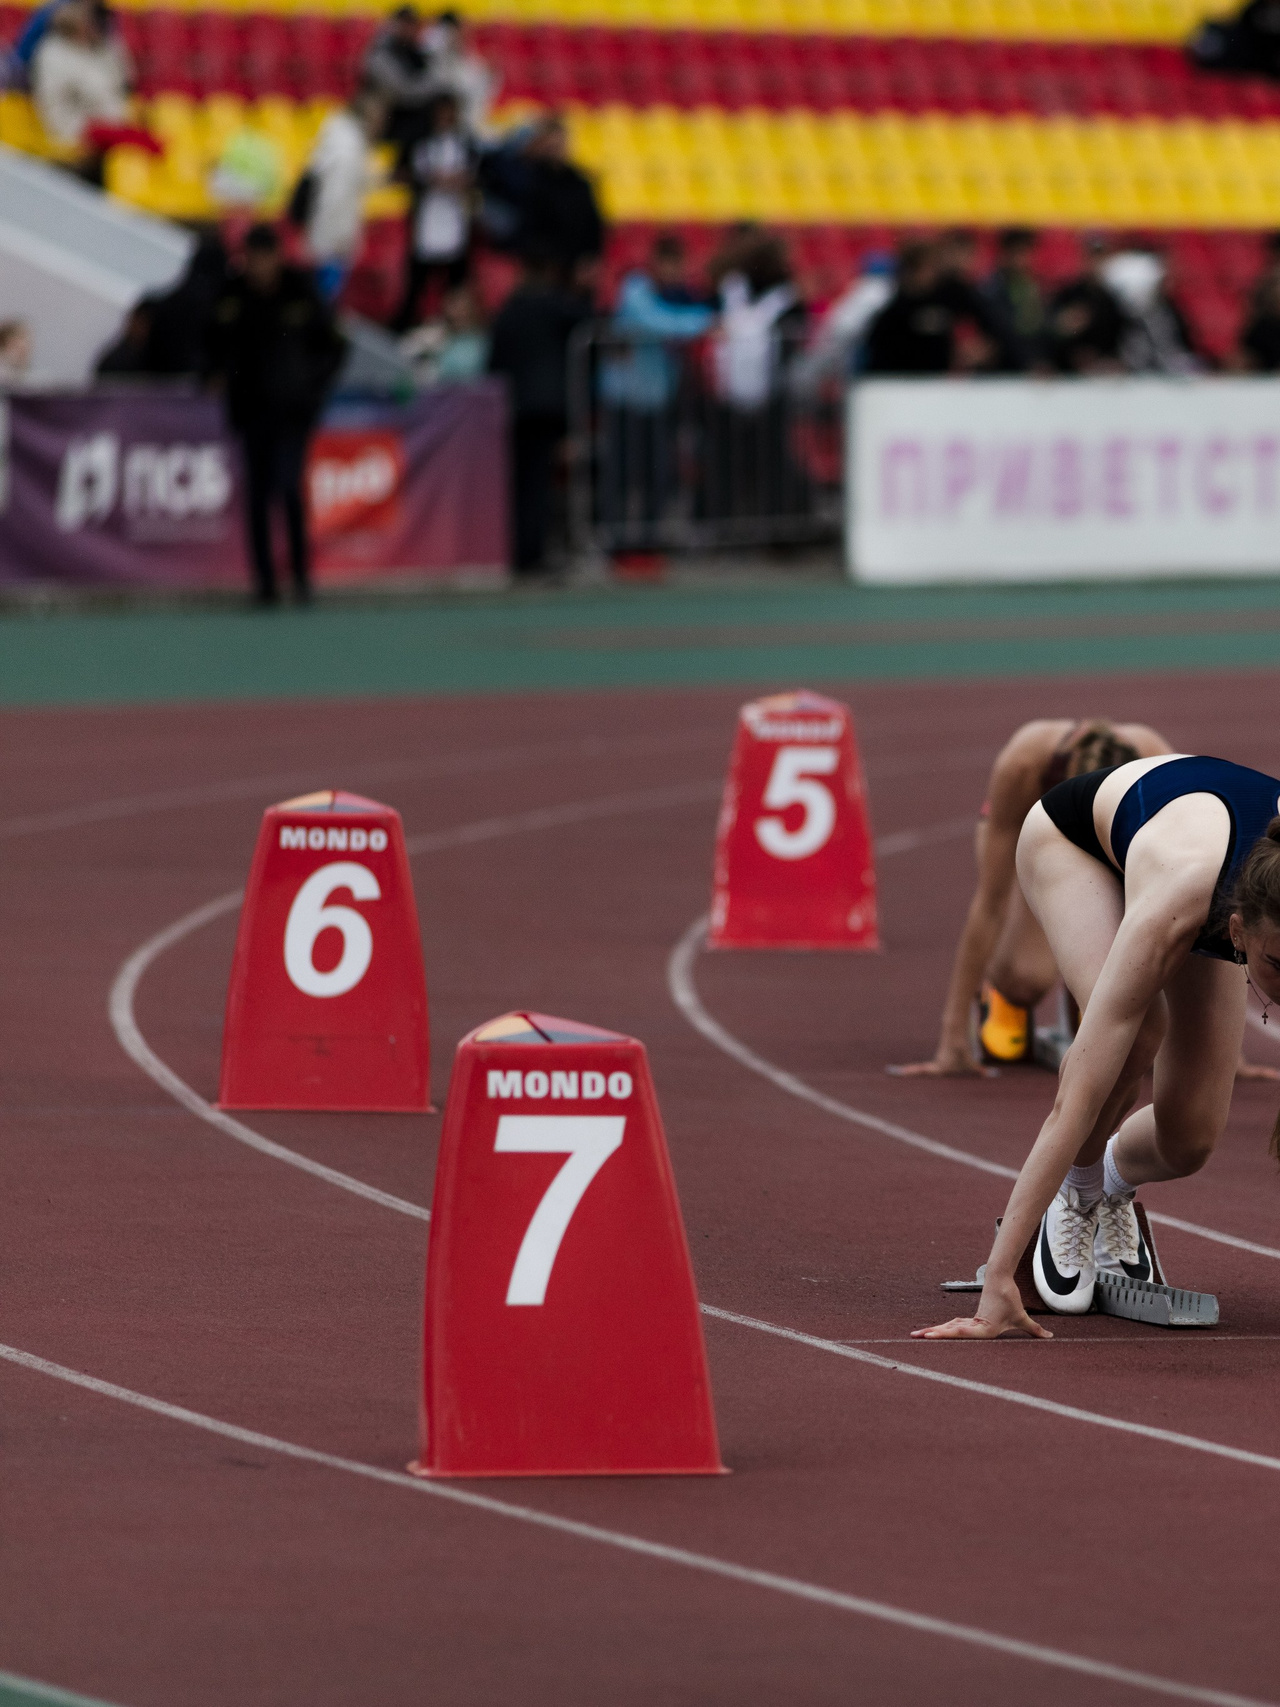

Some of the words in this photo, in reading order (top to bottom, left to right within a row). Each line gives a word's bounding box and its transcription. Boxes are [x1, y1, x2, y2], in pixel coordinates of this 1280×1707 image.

[279, 826, 388, 852] MONDO
[754, 745, 840, 861] 5
[283, 861, 382, 998] 6
[487, 1070, 633, 1099] MONDO
[493, 1115, 627, 1306] 7
